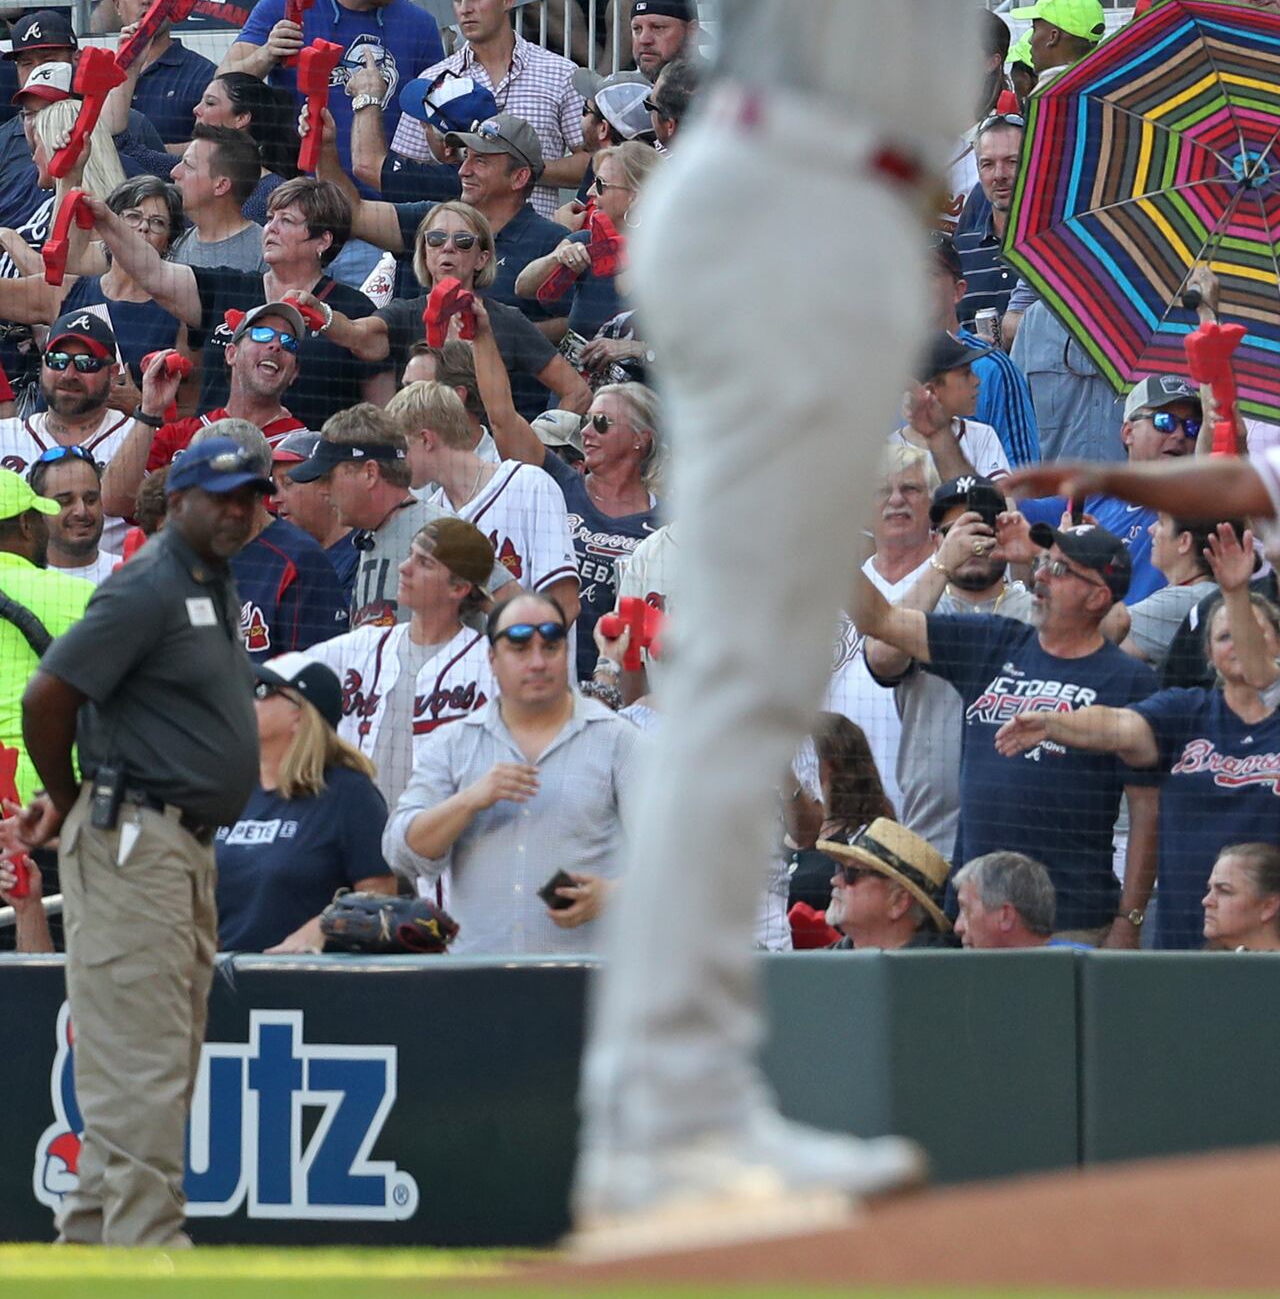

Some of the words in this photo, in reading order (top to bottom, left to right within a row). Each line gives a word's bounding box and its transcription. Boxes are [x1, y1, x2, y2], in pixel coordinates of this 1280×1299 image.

[21, 22, 42, 41] A
[68, 315, 90, 330] A
[579, 583, 597, 603] A
